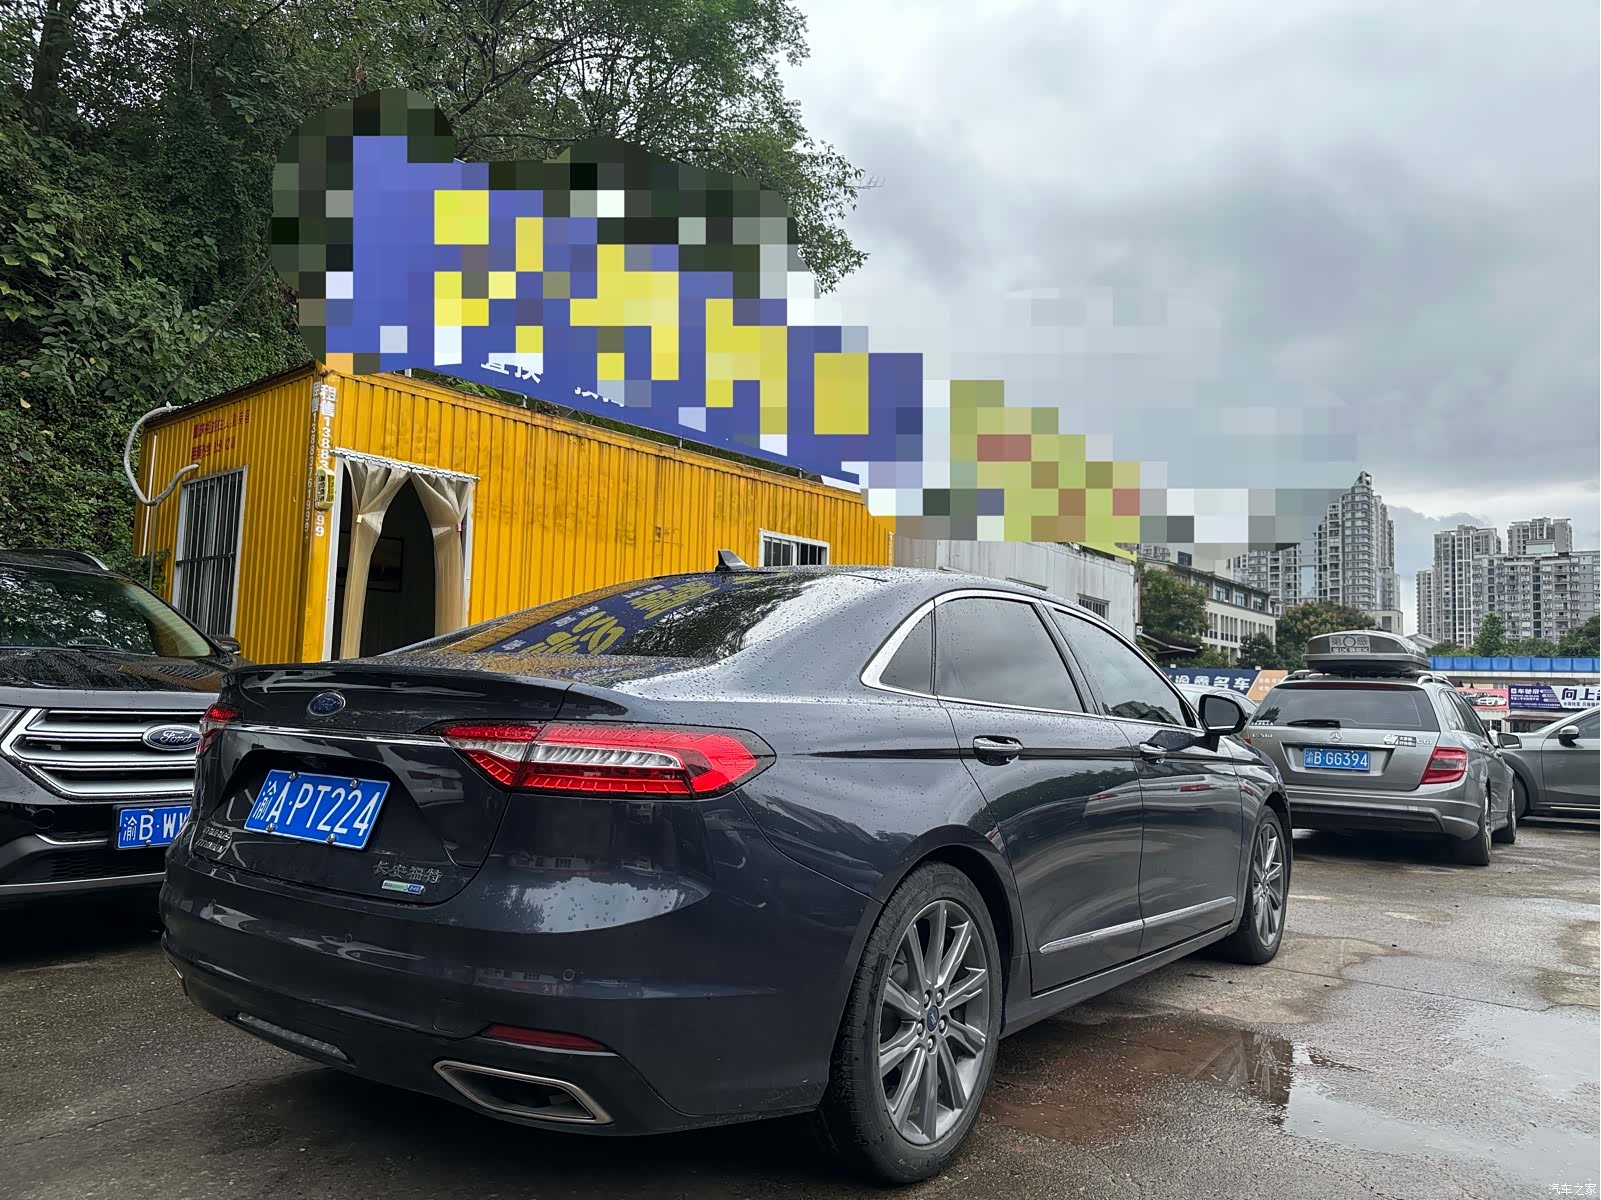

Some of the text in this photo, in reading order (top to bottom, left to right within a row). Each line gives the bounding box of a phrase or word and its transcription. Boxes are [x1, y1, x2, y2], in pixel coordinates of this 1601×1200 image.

[160, 730, 192, 743] Ford
[373, 861, 442, 884] 长安福特
